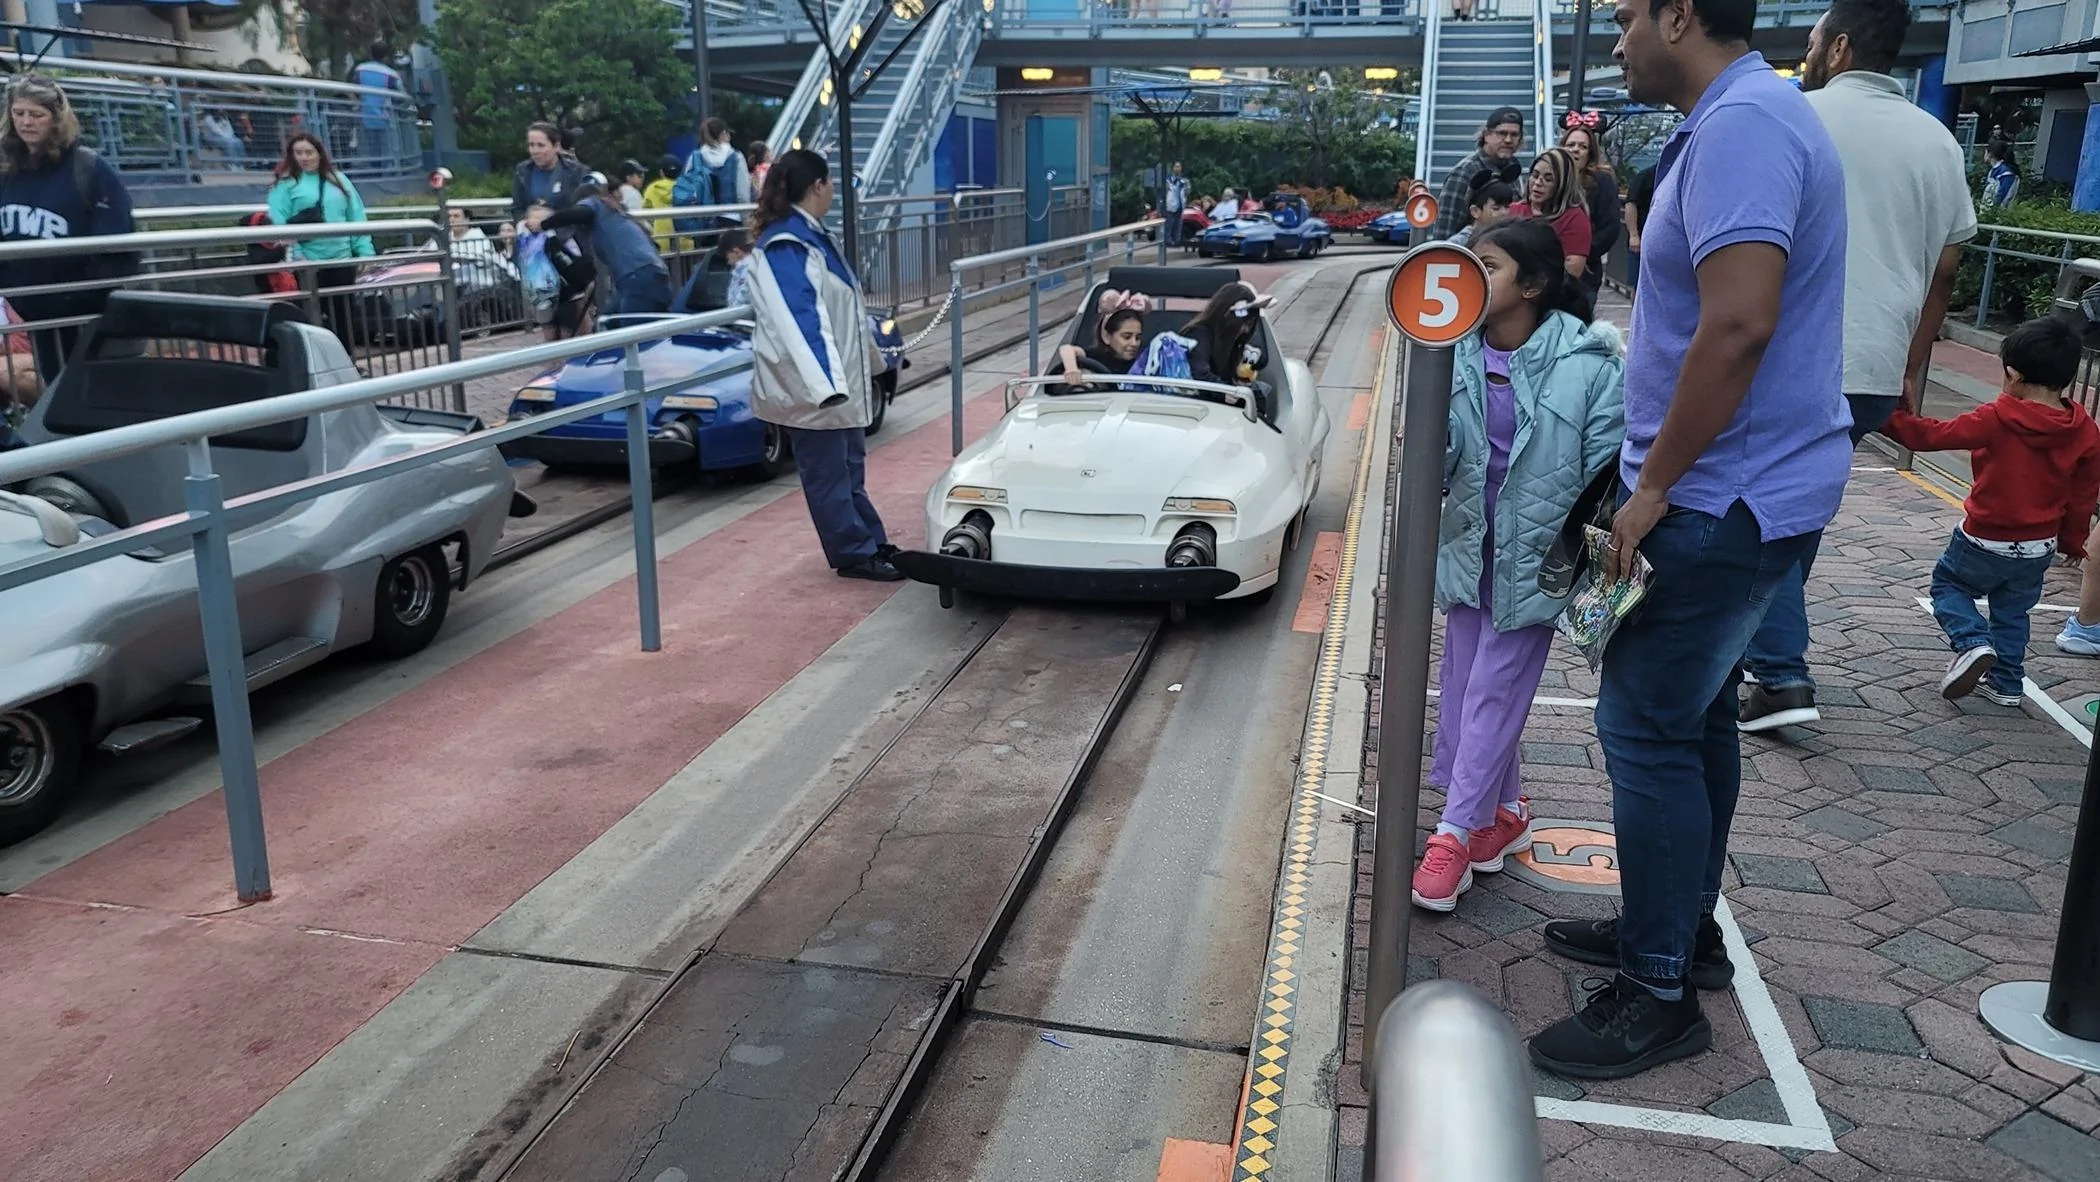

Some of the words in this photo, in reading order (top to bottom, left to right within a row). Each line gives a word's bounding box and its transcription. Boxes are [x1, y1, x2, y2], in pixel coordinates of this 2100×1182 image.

[1413, 199, 1429, 222] 6
[1418, 263, 1460, 328] 5
[1531, 841, 1620, 870] 5
